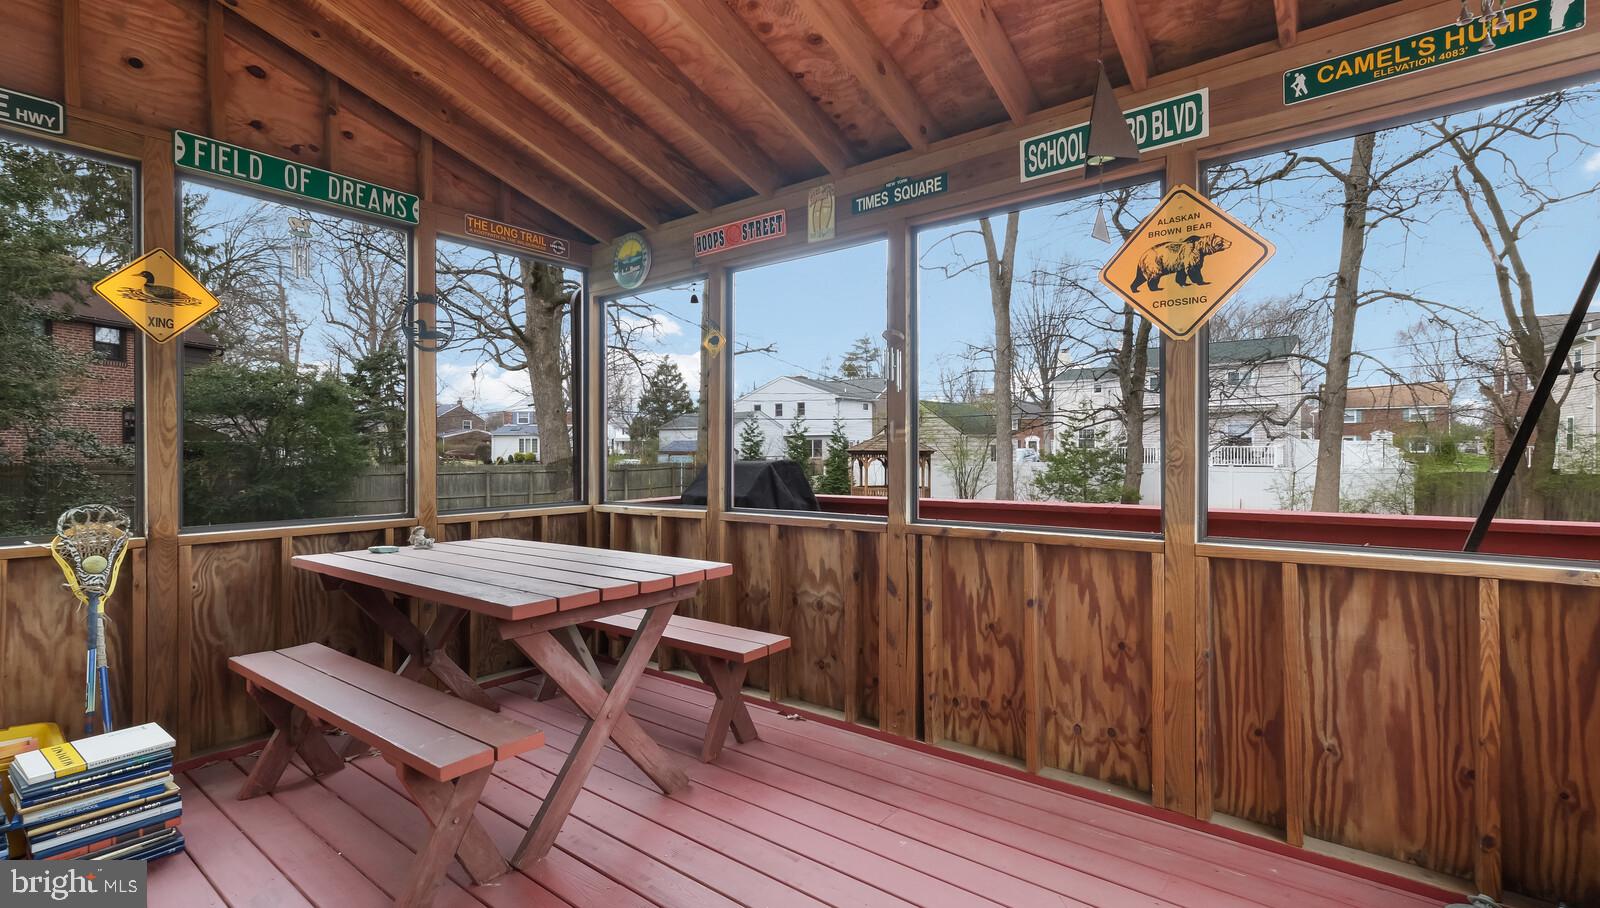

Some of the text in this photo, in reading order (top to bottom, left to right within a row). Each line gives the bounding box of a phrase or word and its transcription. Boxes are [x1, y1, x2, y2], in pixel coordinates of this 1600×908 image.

[1317, 7, 1538, 83] CAMEL'S HUMP
[1373, 55, 1436, 78] ELEVATION
[16, 107, 56, 127] HWY
[1152, 101, 1197, 141] BLVD
[194, 139, 407, 218] FIELD OF DREAMS
[856, 191, 889, 212] TIMES
[894, 176, 943, 202] SQUARE
[467, 217, 488, 231] THE
[491, 223, 518, 239] LONG
[521, 231, 547, 246] TRAIL
[1148, 221, 1212, 239] BROWN BEAR
[1157, 212, 1201, 226] ALASKAN
[696, 214, 783, 252] HOOPS STREET
[1152, 295, 1208, 309] CROSSING
[148, 316, 174, 329] XING
